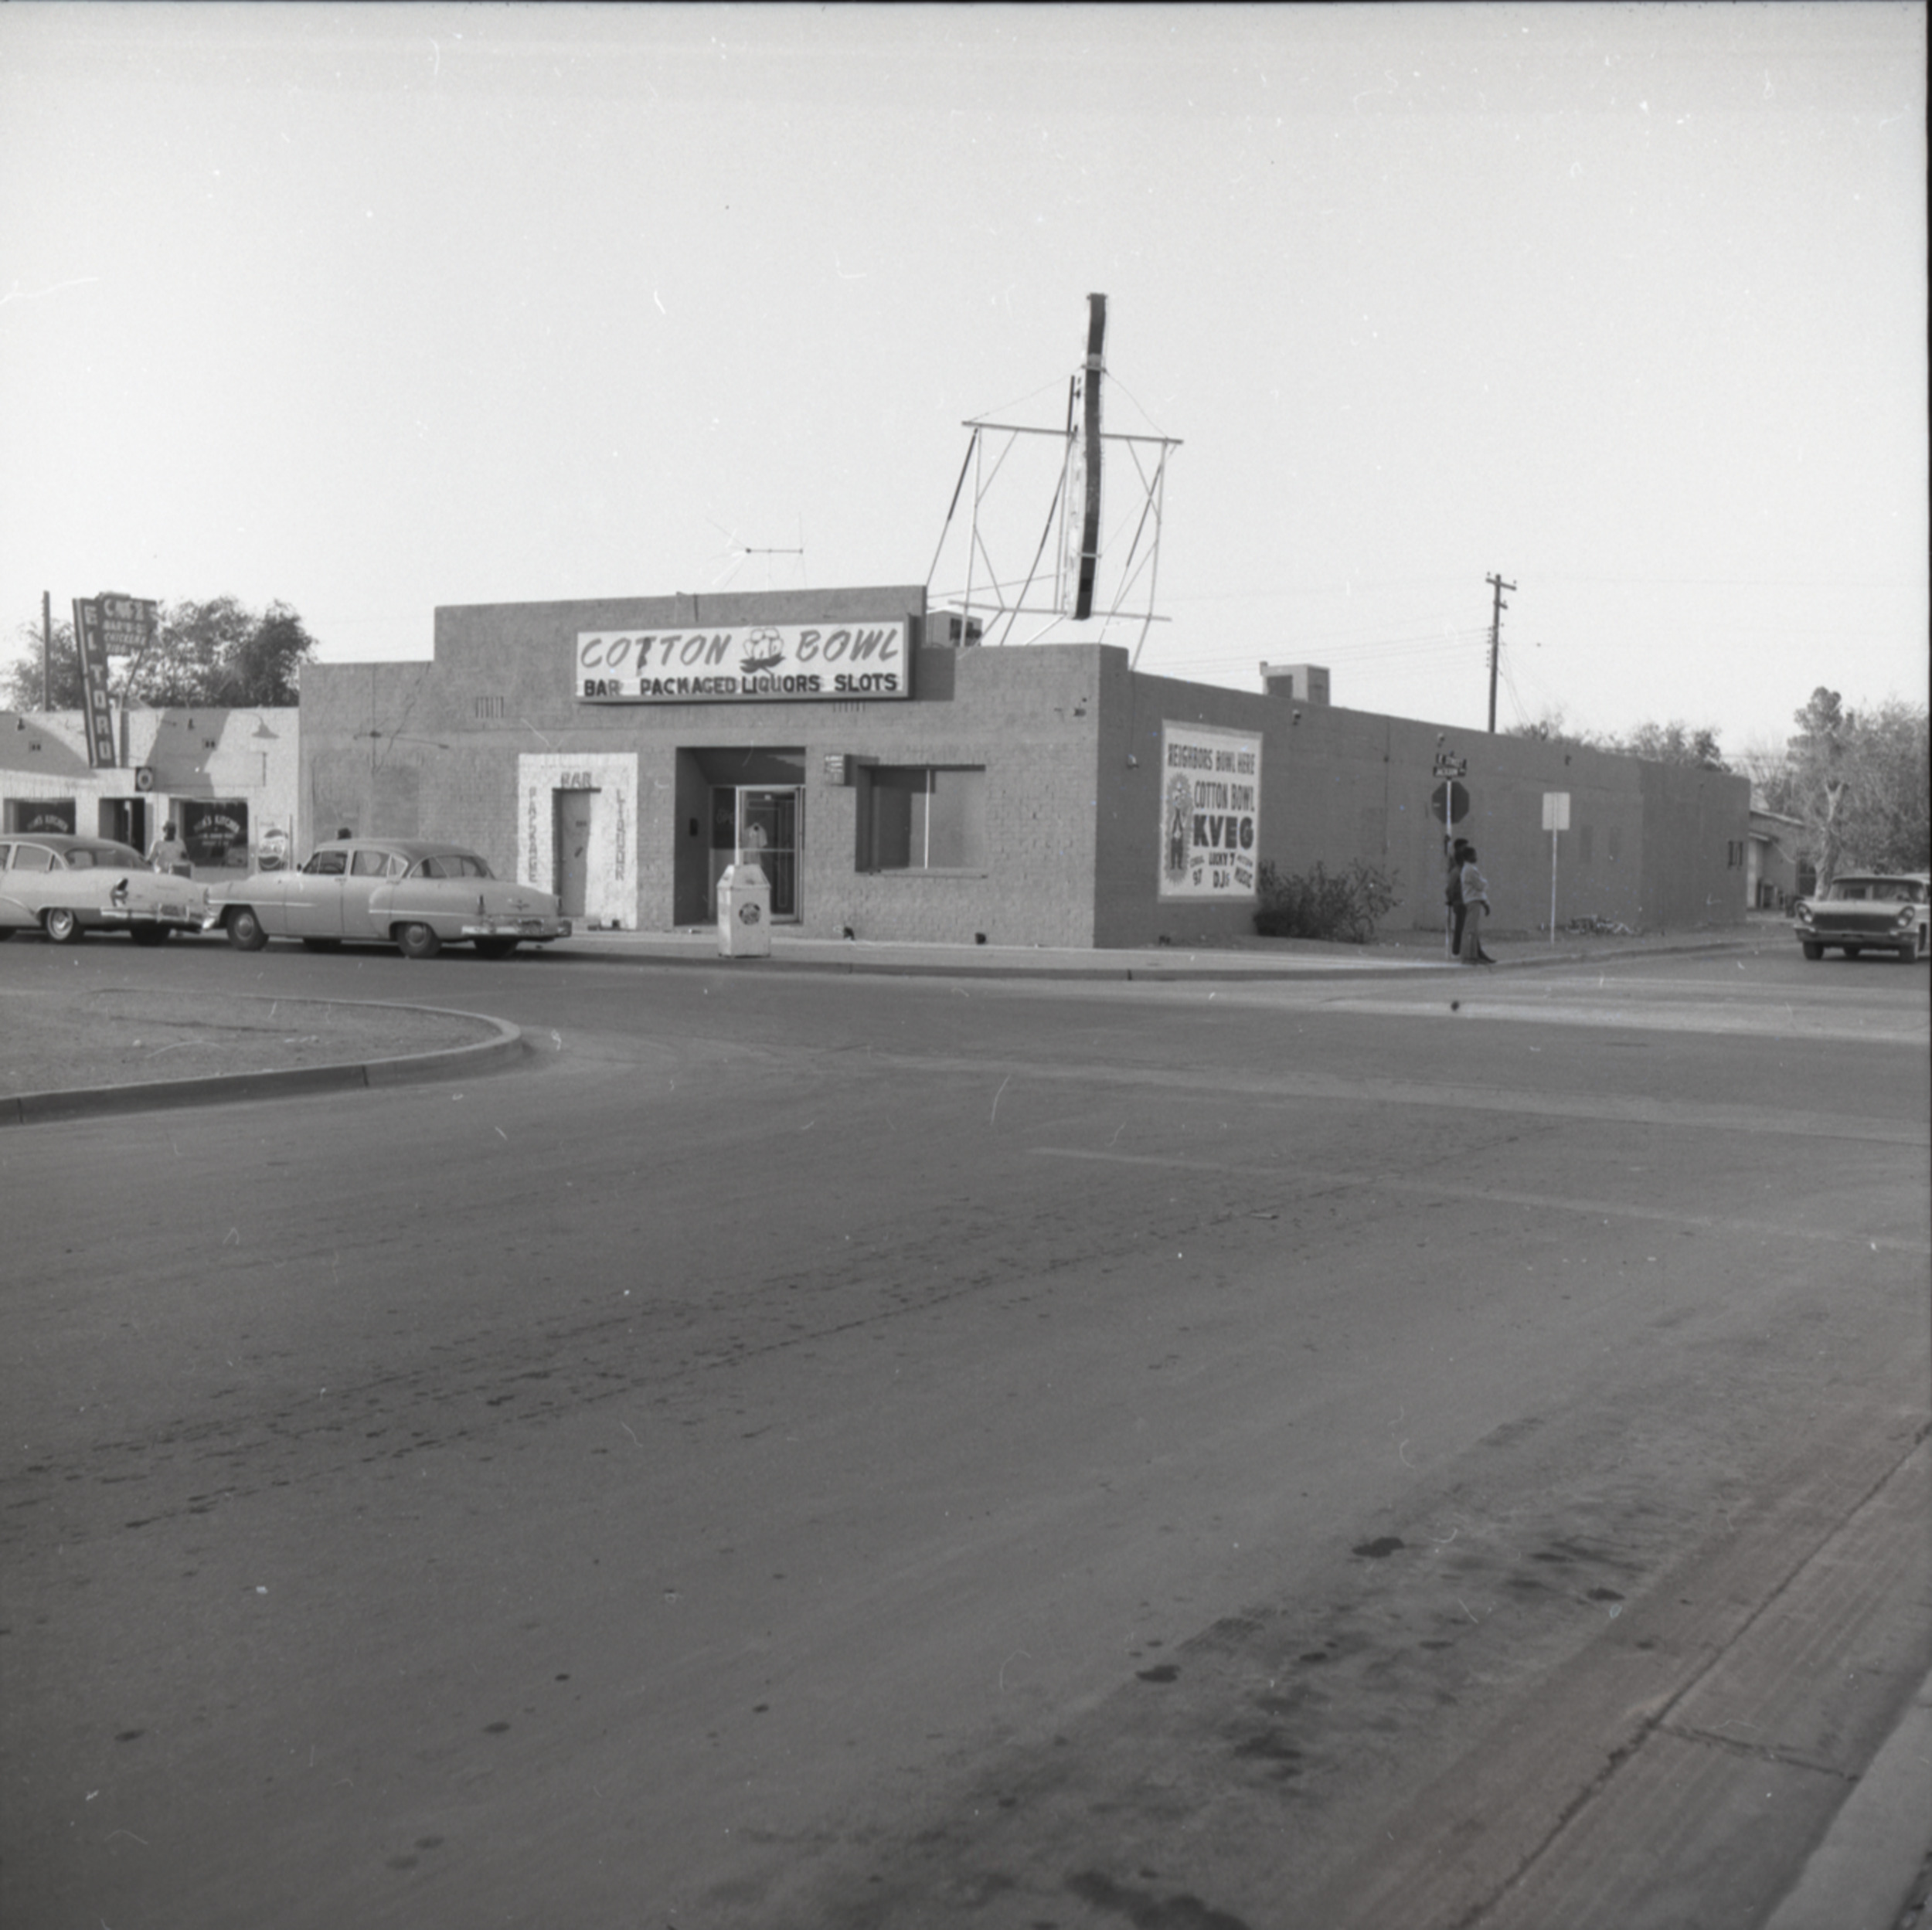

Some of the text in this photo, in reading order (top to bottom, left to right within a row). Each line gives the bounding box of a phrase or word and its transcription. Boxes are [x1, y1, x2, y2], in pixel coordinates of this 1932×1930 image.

[580, 628, 898, 670] COTTON BOWL
[583, 673, 897, 696] BAR PACKAGED LIQUORS SLOTS
[90, 664, 112, 759] TORO
[1168, 742, 1255, 776] NEIGHBORS BOWL HERE
[561, 771, 591, 788] BAR
[1194, 780, 1255, 813] COTTON BOWL
[528, 787, 538, 882] PACKAGE
[616, 789, 626, 881] LIQUOR
[1193, 814, 1254, 851] KVEG
[1209, 851, 1229, 866] LUCKY
